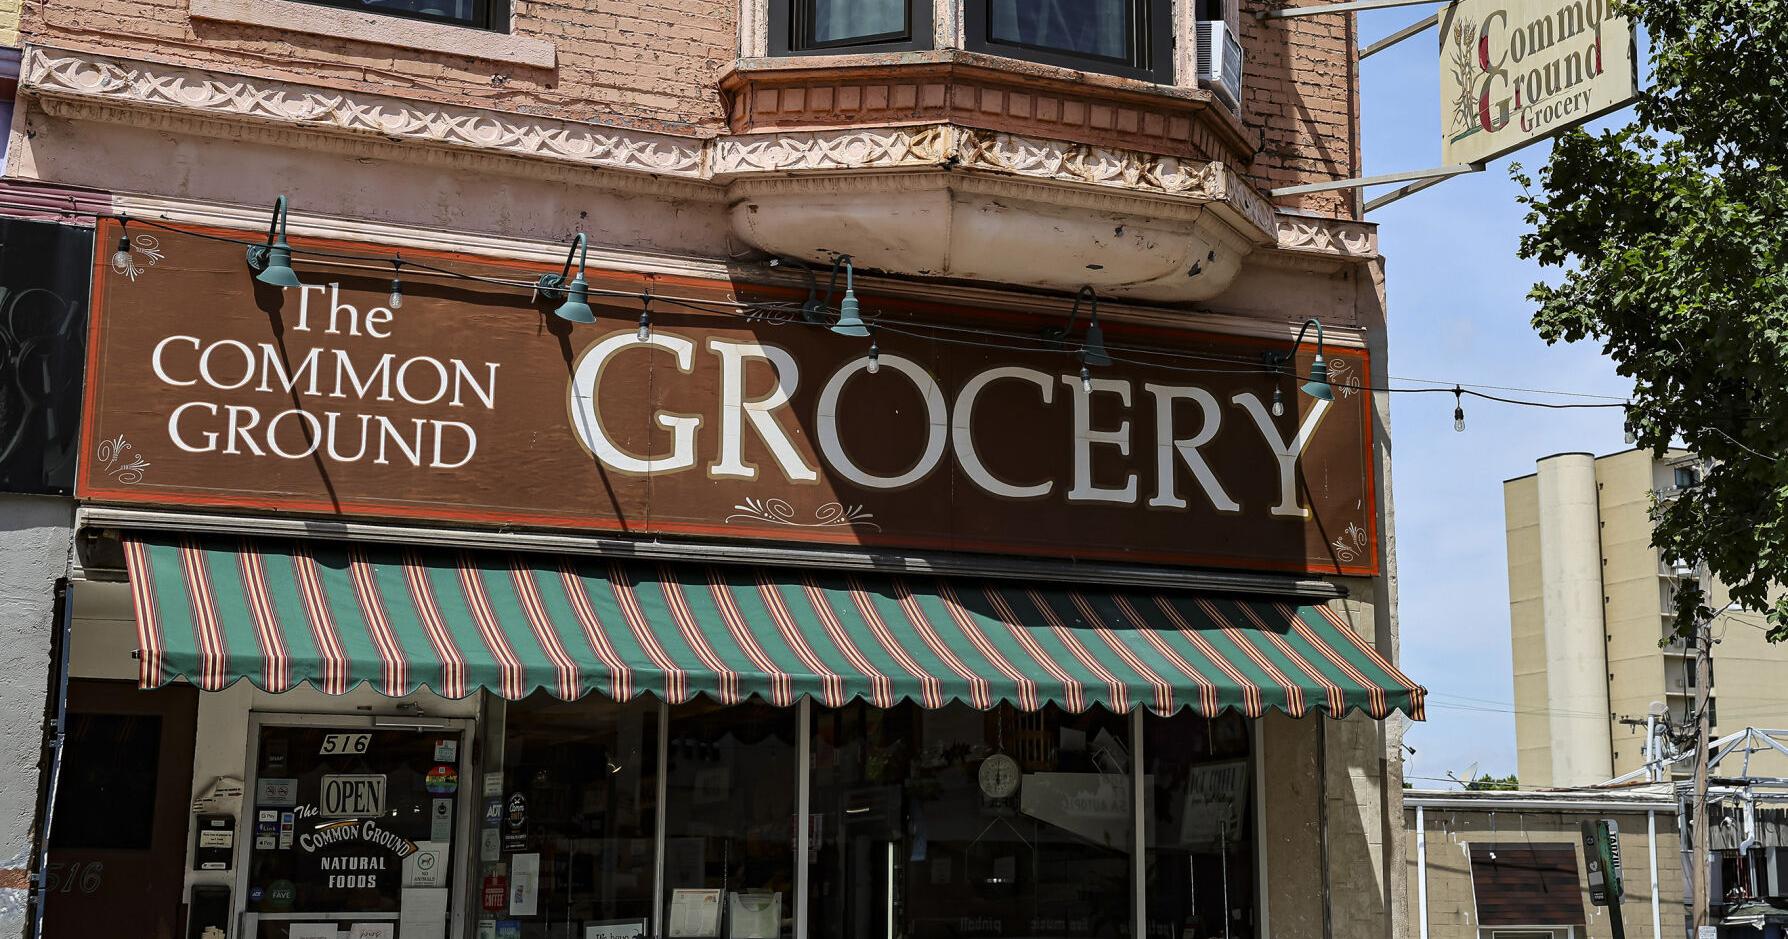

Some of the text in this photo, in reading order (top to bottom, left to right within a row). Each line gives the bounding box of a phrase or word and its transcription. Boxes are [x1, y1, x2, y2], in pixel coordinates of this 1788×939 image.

[1478, 28, 1604, 133] Ground
[1520, 88, 1592, 133] Grocery
[283, 282, 393, 338] The
[152, 334, 500, 410] COMMON
[168, 401, 478, 469] GROUND
[568, 331, 1334, 519] GROCERY
[323, 735, 368, 753] 516
[294, 803, 319, 819] The
[325, 779, 380, 814] OPEN
[486, 804, 502, 818] ADT
[299, 824, 360, 853] COMMON
[362, 819, 411, 857] GROUND
[320, 856, 387, 870] NATURAL
[328, 875, 377, 889] FOODS
